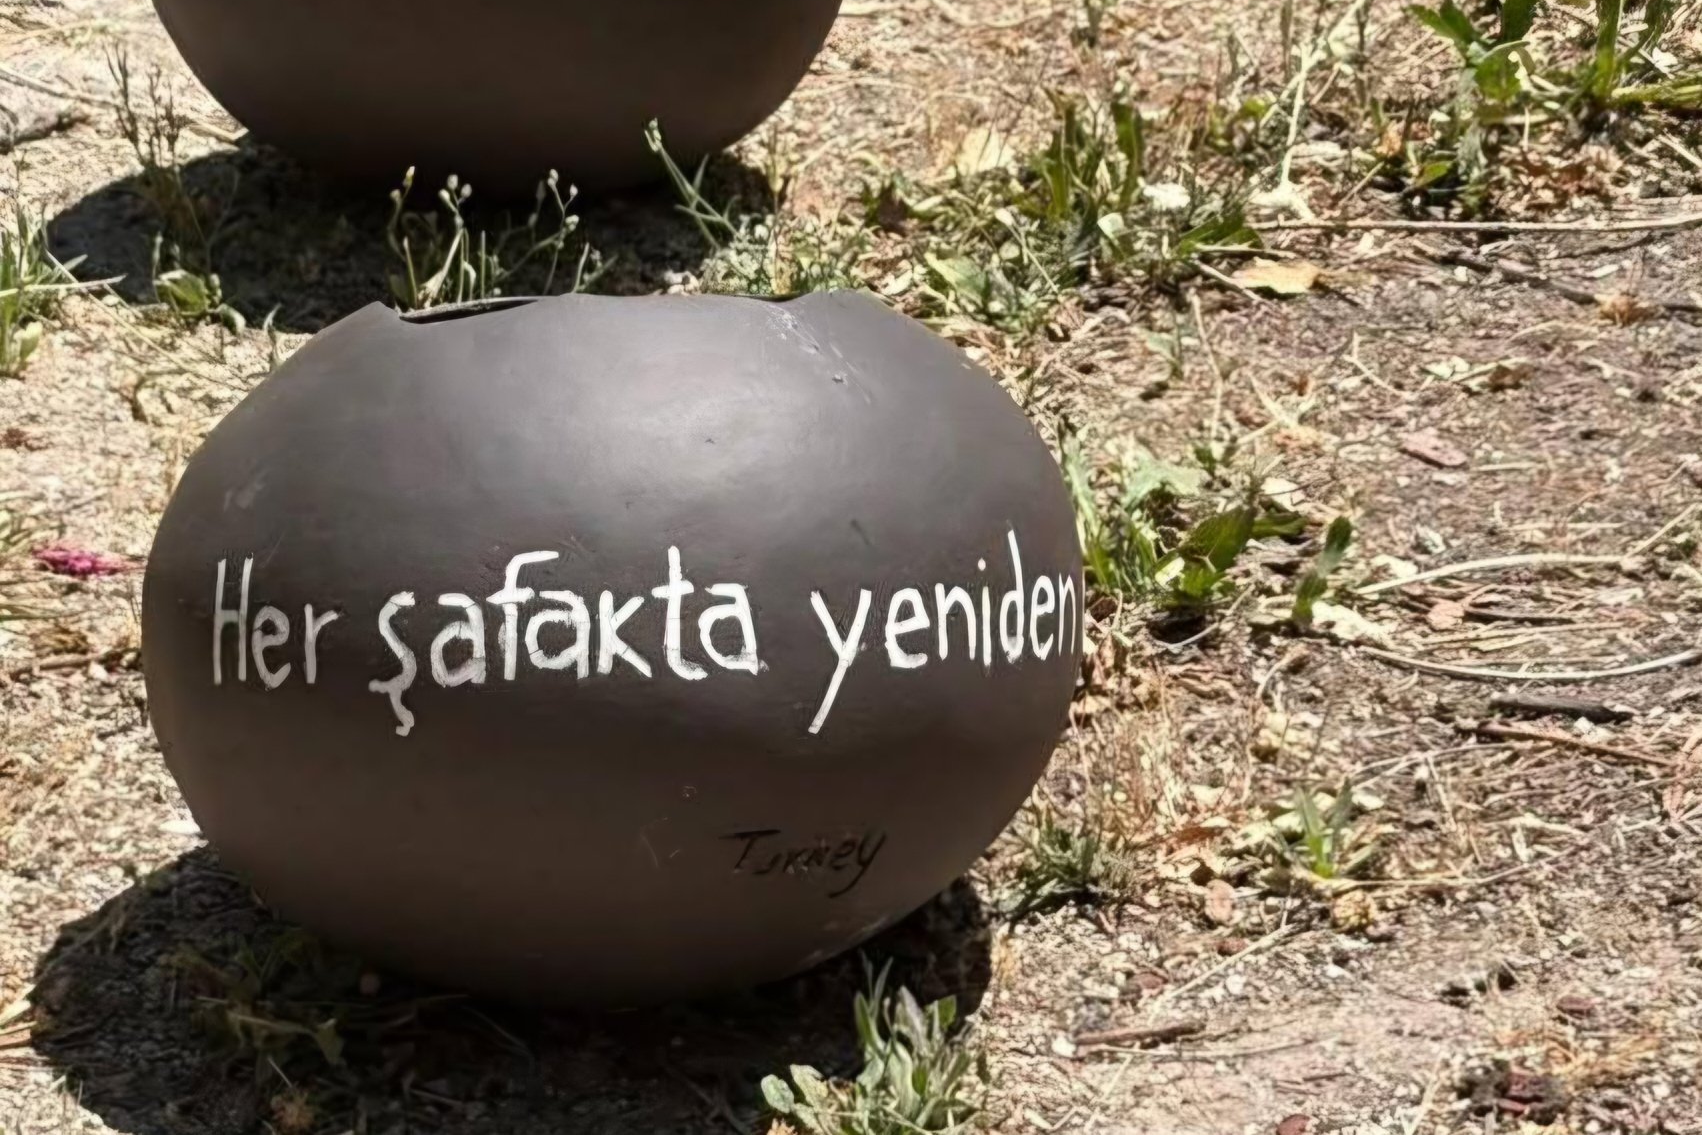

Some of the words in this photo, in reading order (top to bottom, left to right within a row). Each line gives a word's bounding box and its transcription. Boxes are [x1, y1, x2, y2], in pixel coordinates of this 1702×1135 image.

[211, 555, 340, 691] Her
[368, 544, 768, 737] şafakta
[807, 529, 1077, 735] yeniden
